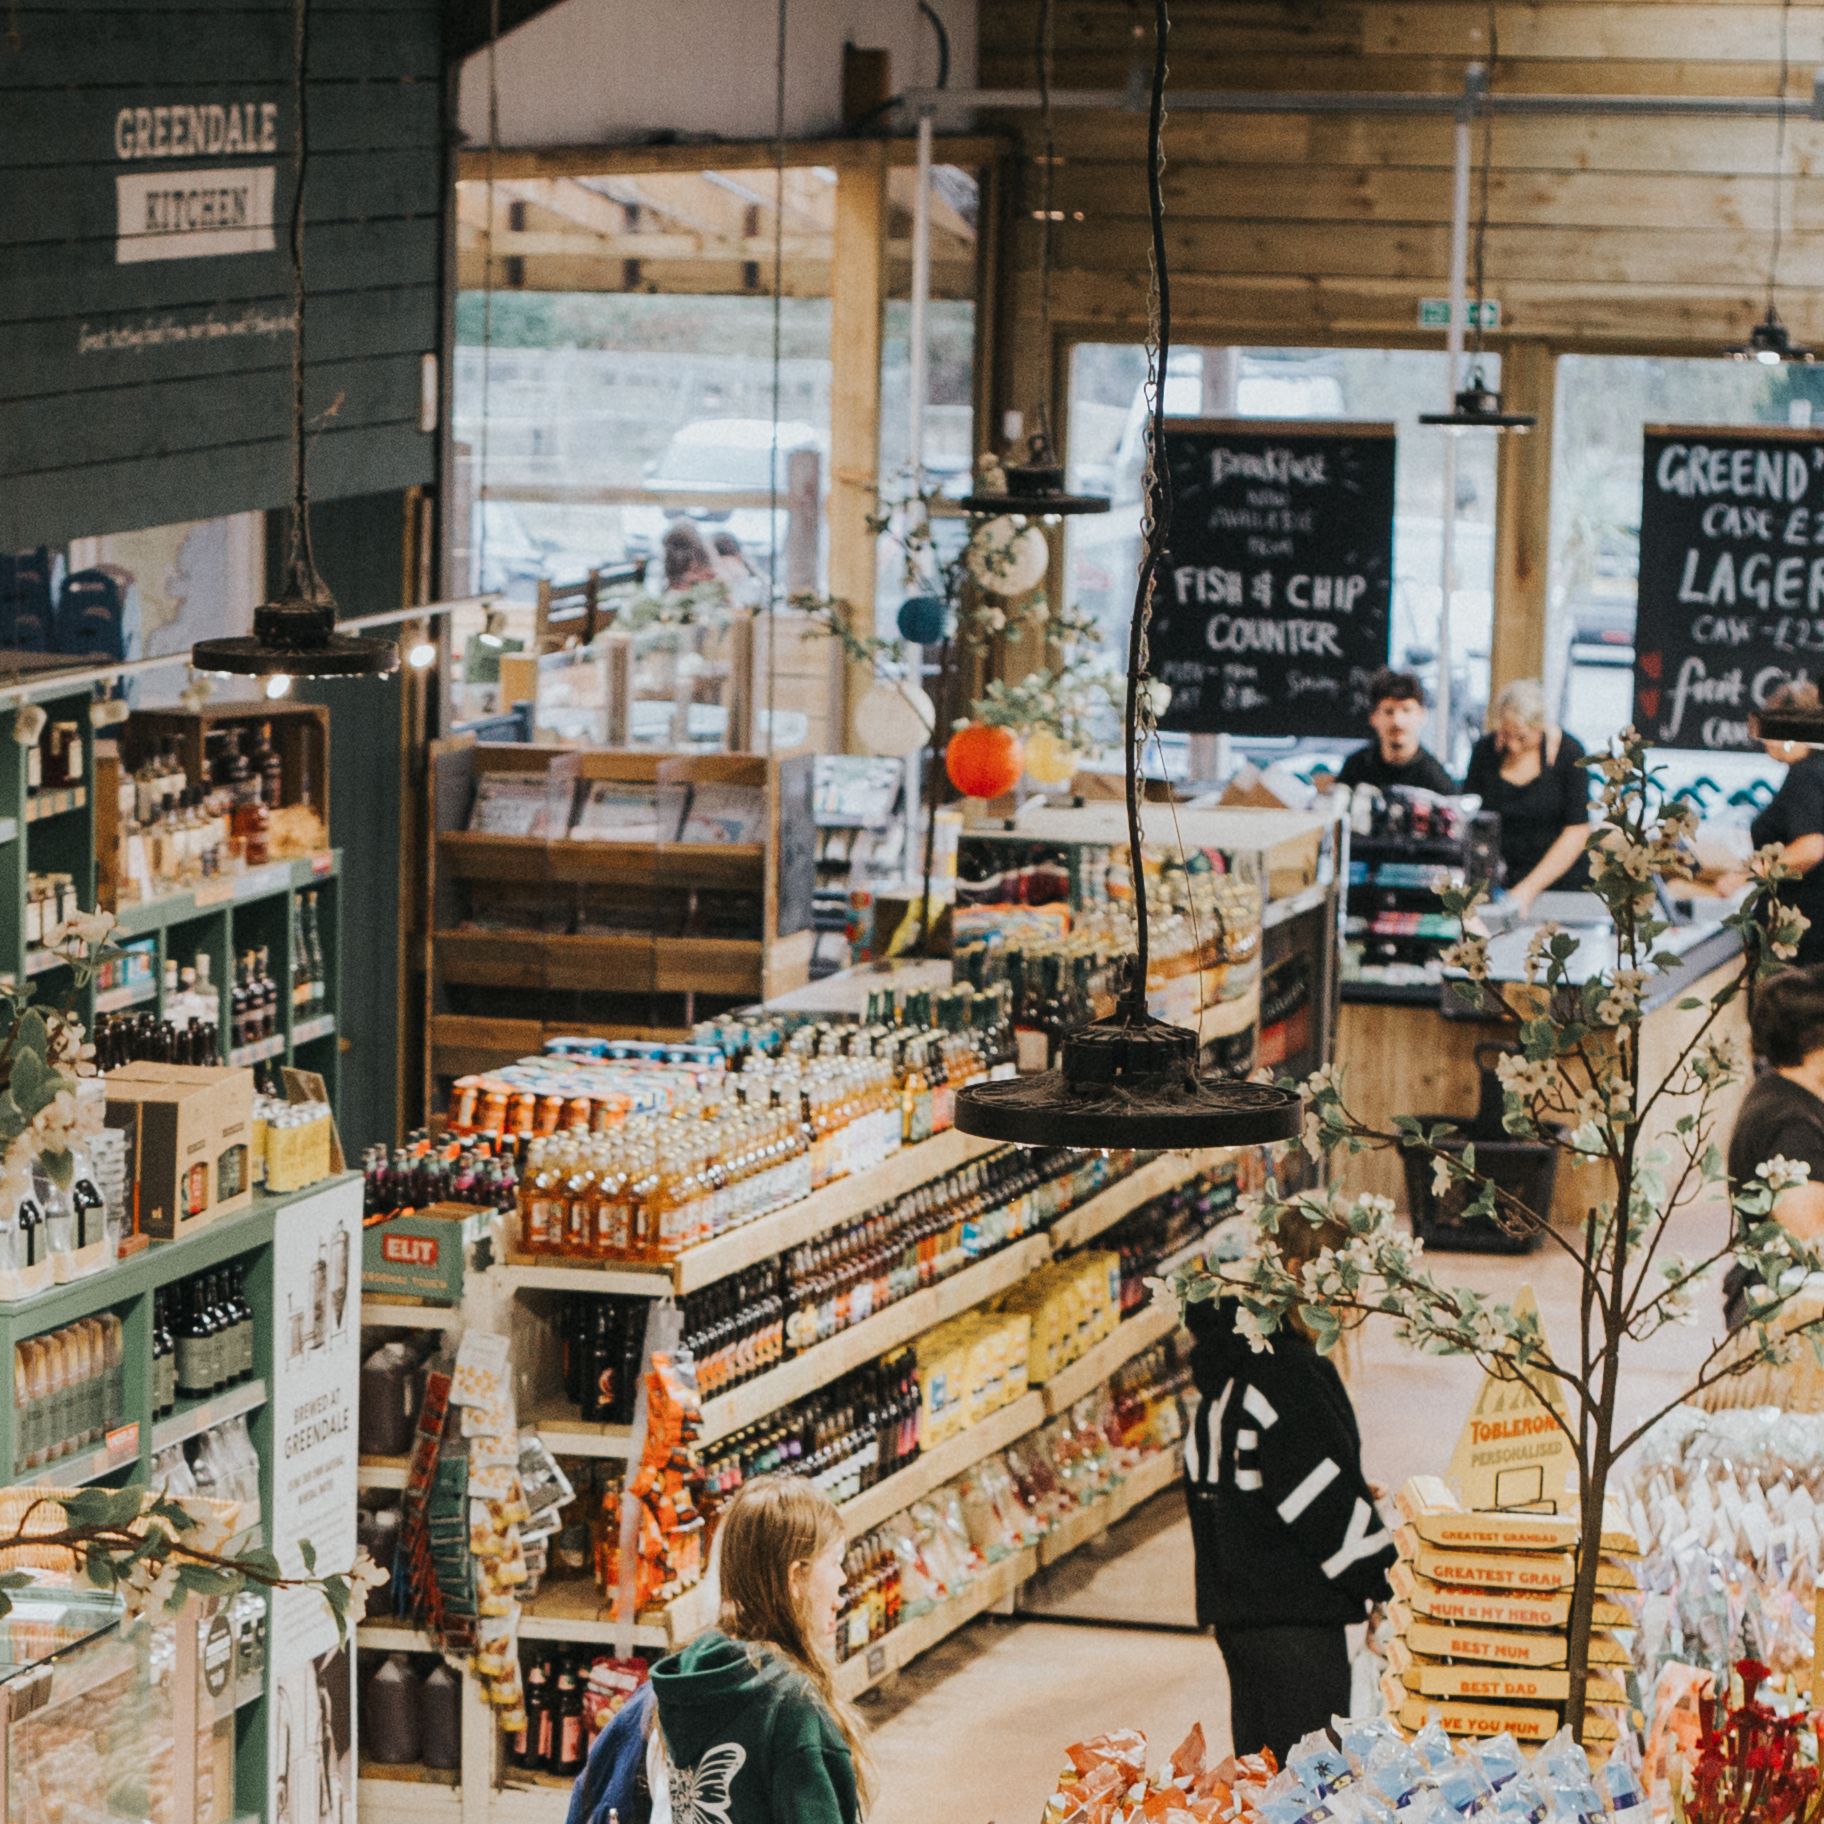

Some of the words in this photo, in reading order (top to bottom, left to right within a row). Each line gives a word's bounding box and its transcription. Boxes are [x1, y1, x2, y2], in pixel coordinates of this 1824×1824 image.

[115, 103, 277, 159] GREENDALE
[146, 186, 248, 230] KITCHEN
[1174, 565, 1243, 607] FISH
[1252, 570, 1272, 609] &
[1287, 573, 1368, 613] CHIP
[1678, 548, 1824, 610] LAGER
[1206, 613, 1344, 658] COUNTER
[284, 1408, 350, 1459] GREENDALE
[1440, 1529, 1500, 1542] GREATEST
[1433, 1565, 1514, 1584] GREATEST
[1519, 1572, 1562, 1585] GRAN
[1481, 1606, 1504, 1619] MY
[1508, 1609, 1552, 1623] HERO
[1451, 1640, 1490, 1656] BEST
[1494, 1646, 1530, 1659] MUM
[1460, 1681, 1500, 1695] BEST
[1504, 1683, 1537, 1695] DAD
[1420, 1714, 1462, 1729] LVE
[1468, 1719, 1500, 1732] YOU
[1504, 1721, 1540, 1734] MUM
